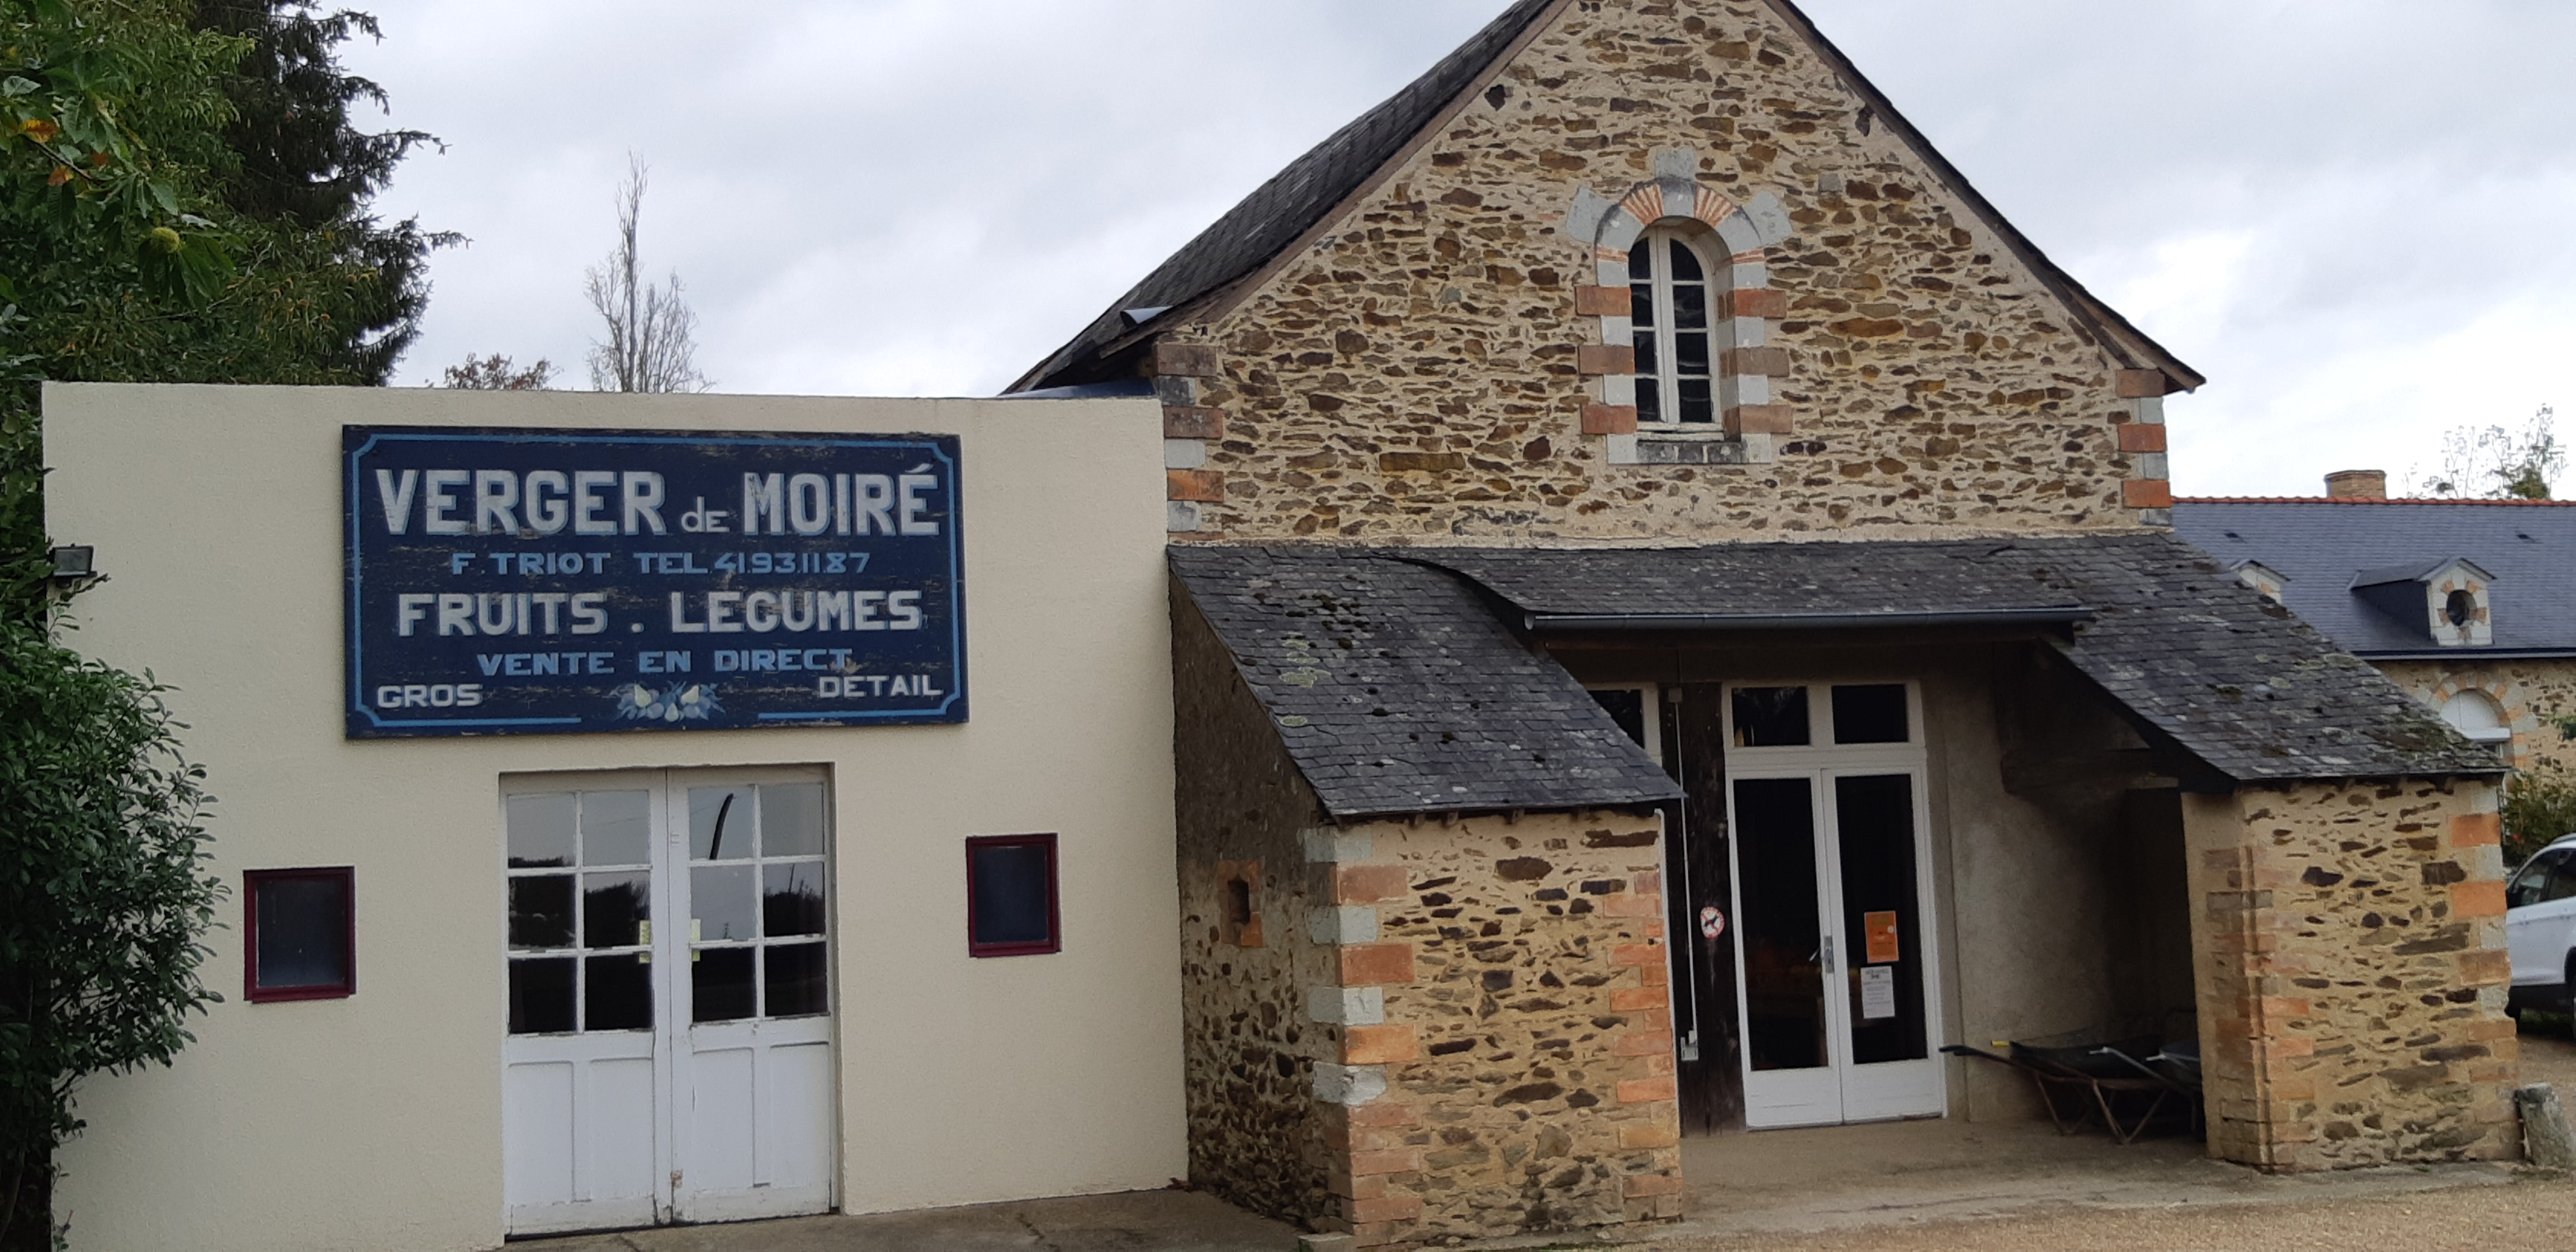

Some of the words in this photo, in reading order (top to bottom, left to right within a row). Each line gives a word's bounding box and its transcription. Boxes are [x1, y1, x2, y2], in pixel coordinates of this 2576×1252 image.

[376, 468, 667, 535] VERGER
[744, 463, 939, 537] MOIRÉ
[488, 552, 612, 576] TRIOT
[397, 592, 608, 637] FRUITS
[671, 590, 924, 633] LEGUMES
[476, 651, 615, 676] VENTE
[638, 650, 692, 674] EN
[714, 648, 853, 672] DIRECT
[377, 683, 483, 709] GROS
[818, 674, 945, 699] DETAIL
